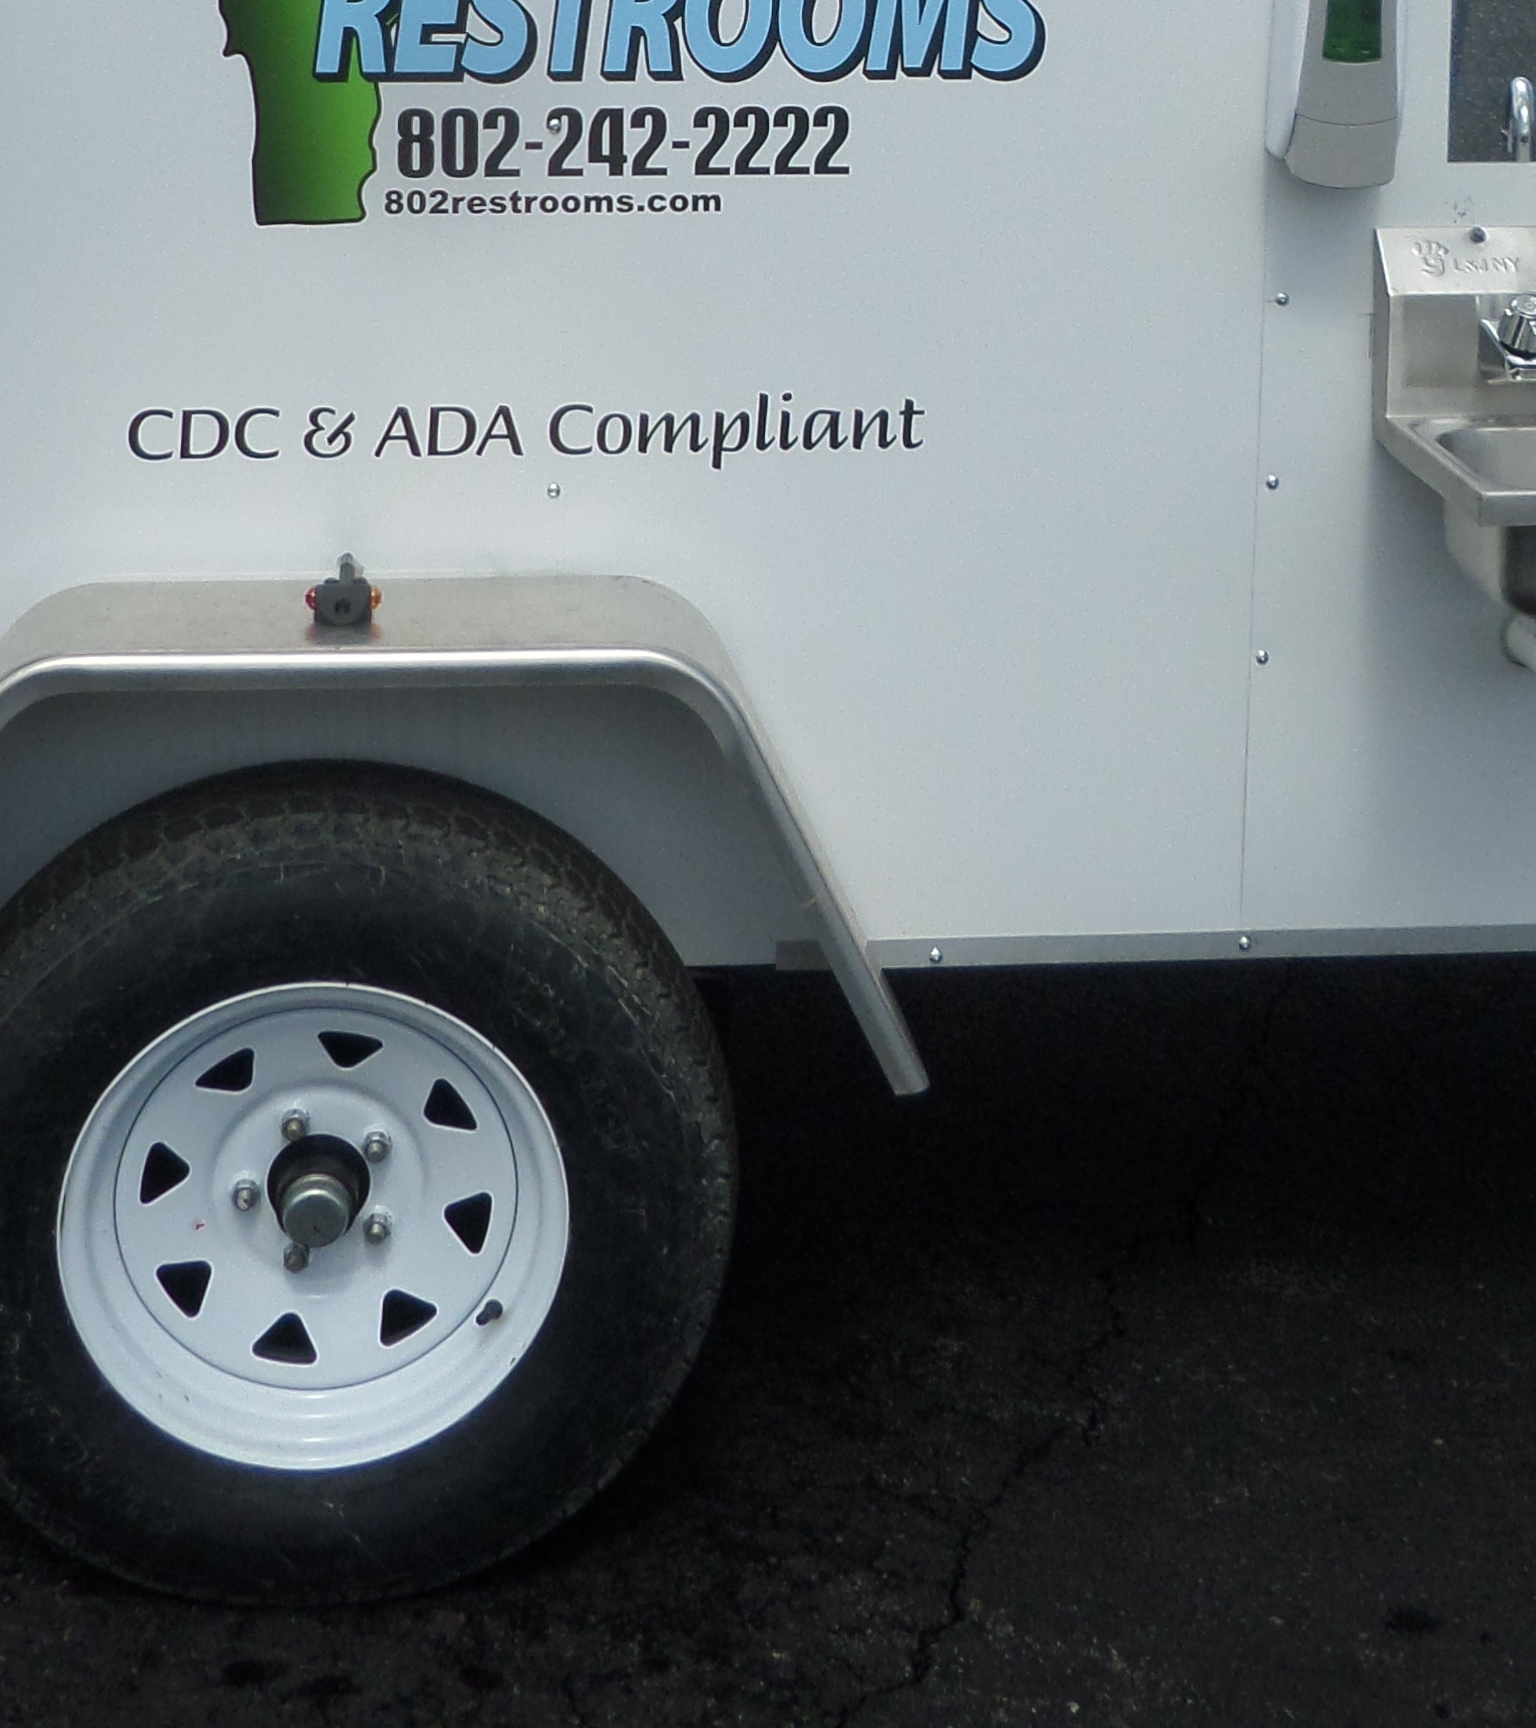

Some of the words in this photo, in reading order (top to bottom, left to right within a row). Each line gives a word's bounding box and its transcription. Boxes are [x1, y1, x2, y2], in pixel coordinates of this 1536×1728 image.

[396, 106, 851, 179] 802-242-2222
[384, 188, 722, 215] 802restrooms.com
[127, 407, 280, 460] CDC
[303, 404, 357, 458] &
[374, 403, 524, 458] ADA
[548, 391, 925, 470] Compliant
